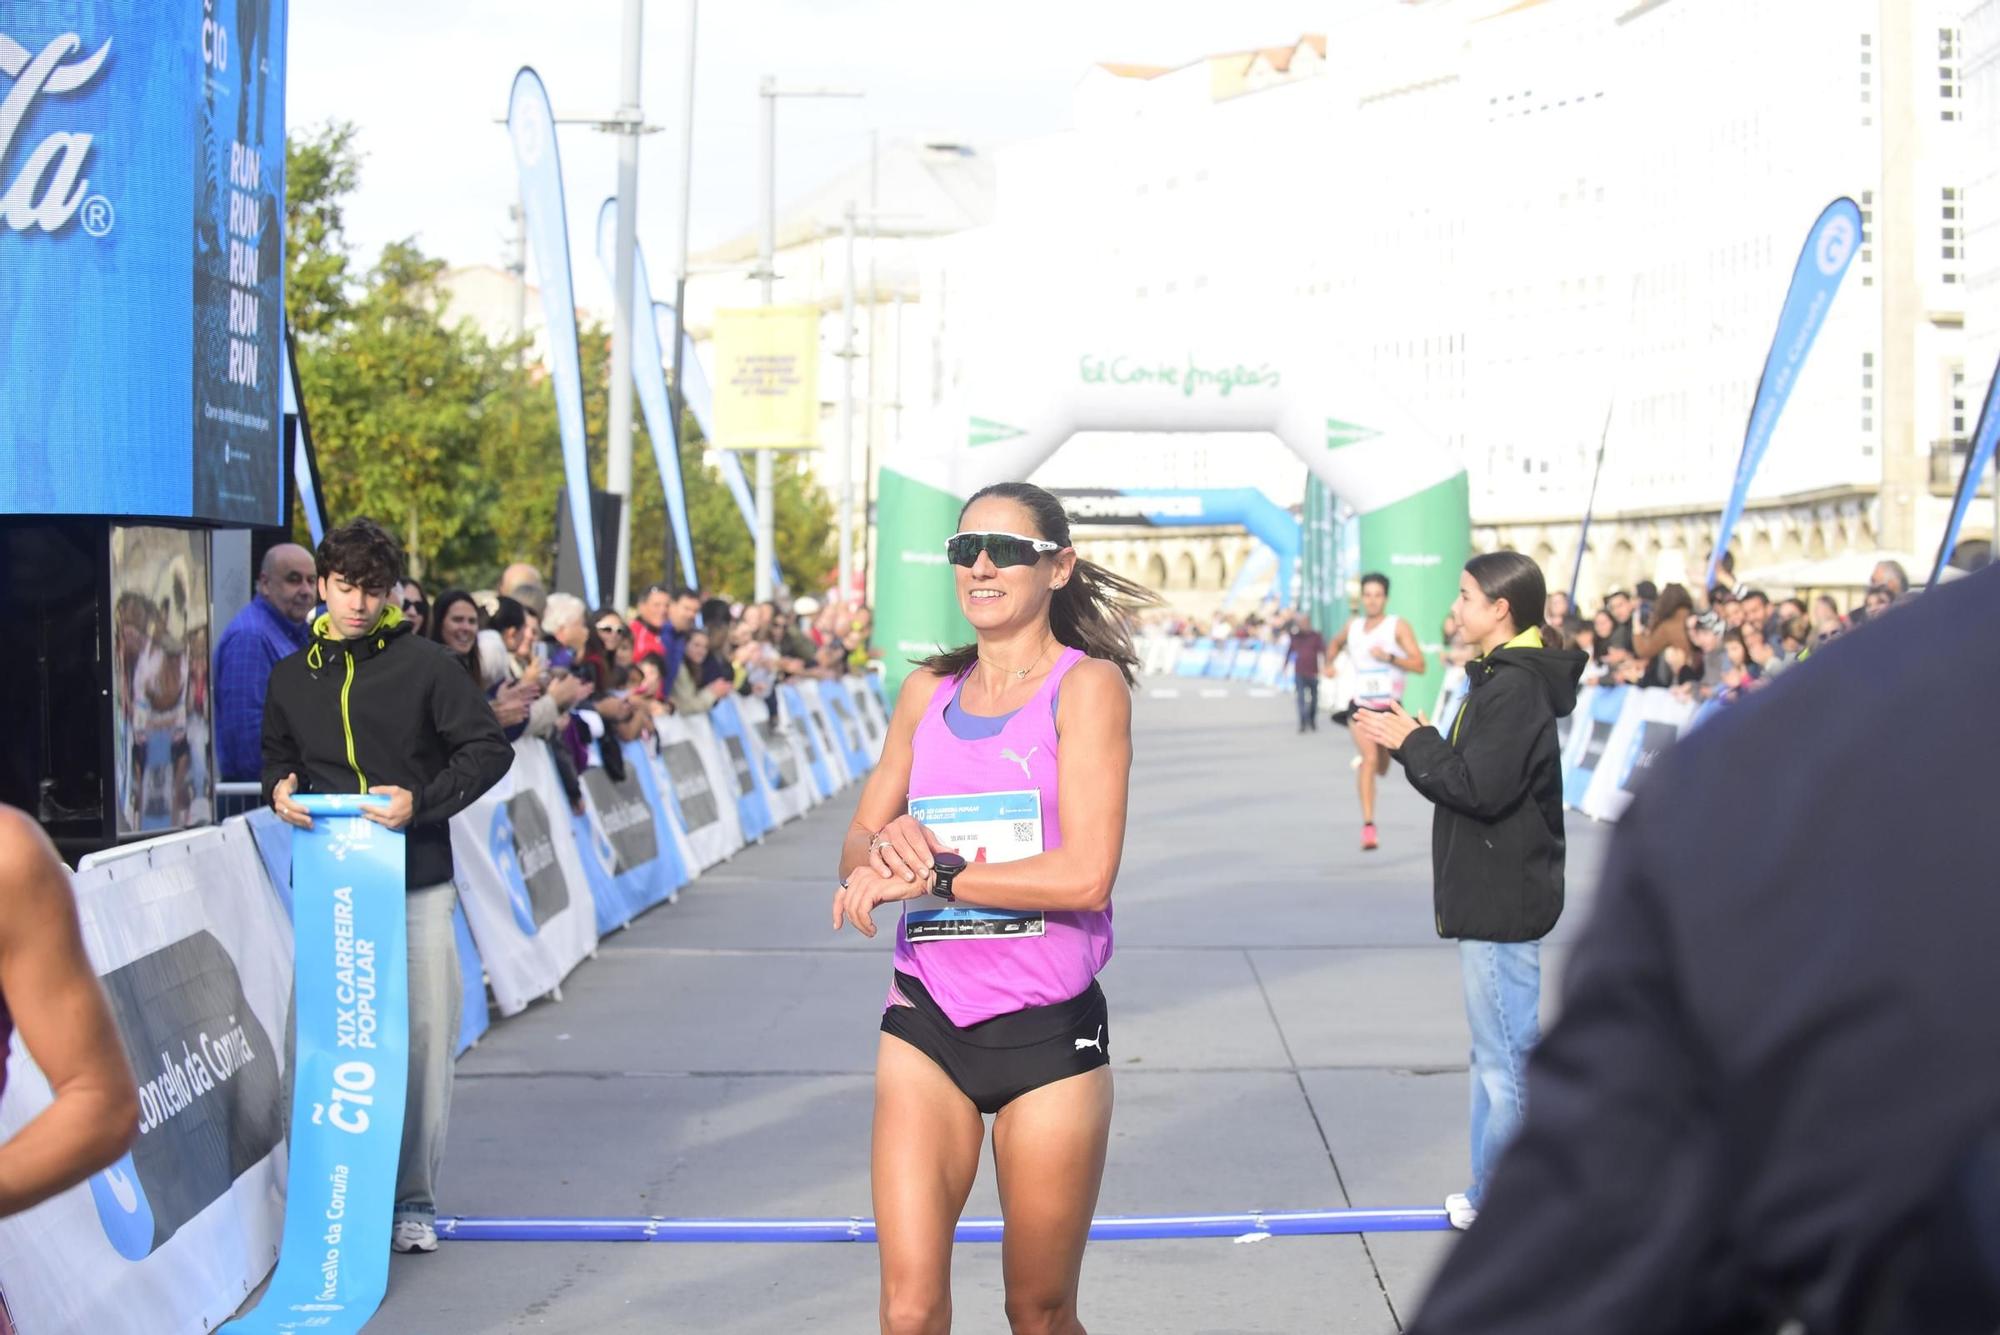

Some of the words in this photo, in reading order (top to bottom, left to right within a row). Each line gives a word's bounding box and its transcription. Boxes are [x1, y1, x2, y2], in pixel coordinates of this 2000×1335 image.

[231, 140, 261, 190] RUN
[230, 188, 259, 239] RUN
[230, 237, 259, 286] RUN
[229, 287, 258, 337] RUN
[229, 336, 258, 388] RUN
[1079, 353, 1106, 384] El
[1110, 354, 1178, 386] Corte
[335, 886, 357, 1004] CARREIRA
[355, 940, 376, 1049] POPULAR
[337, 1008, 357, 1048] XIX
[182, 1040, 215, 1096] da
[326, 1164, 349, 1219] Coruña
[323, 1222, 341, 1244] da
[315, 1244, 341, 1302] ncello
